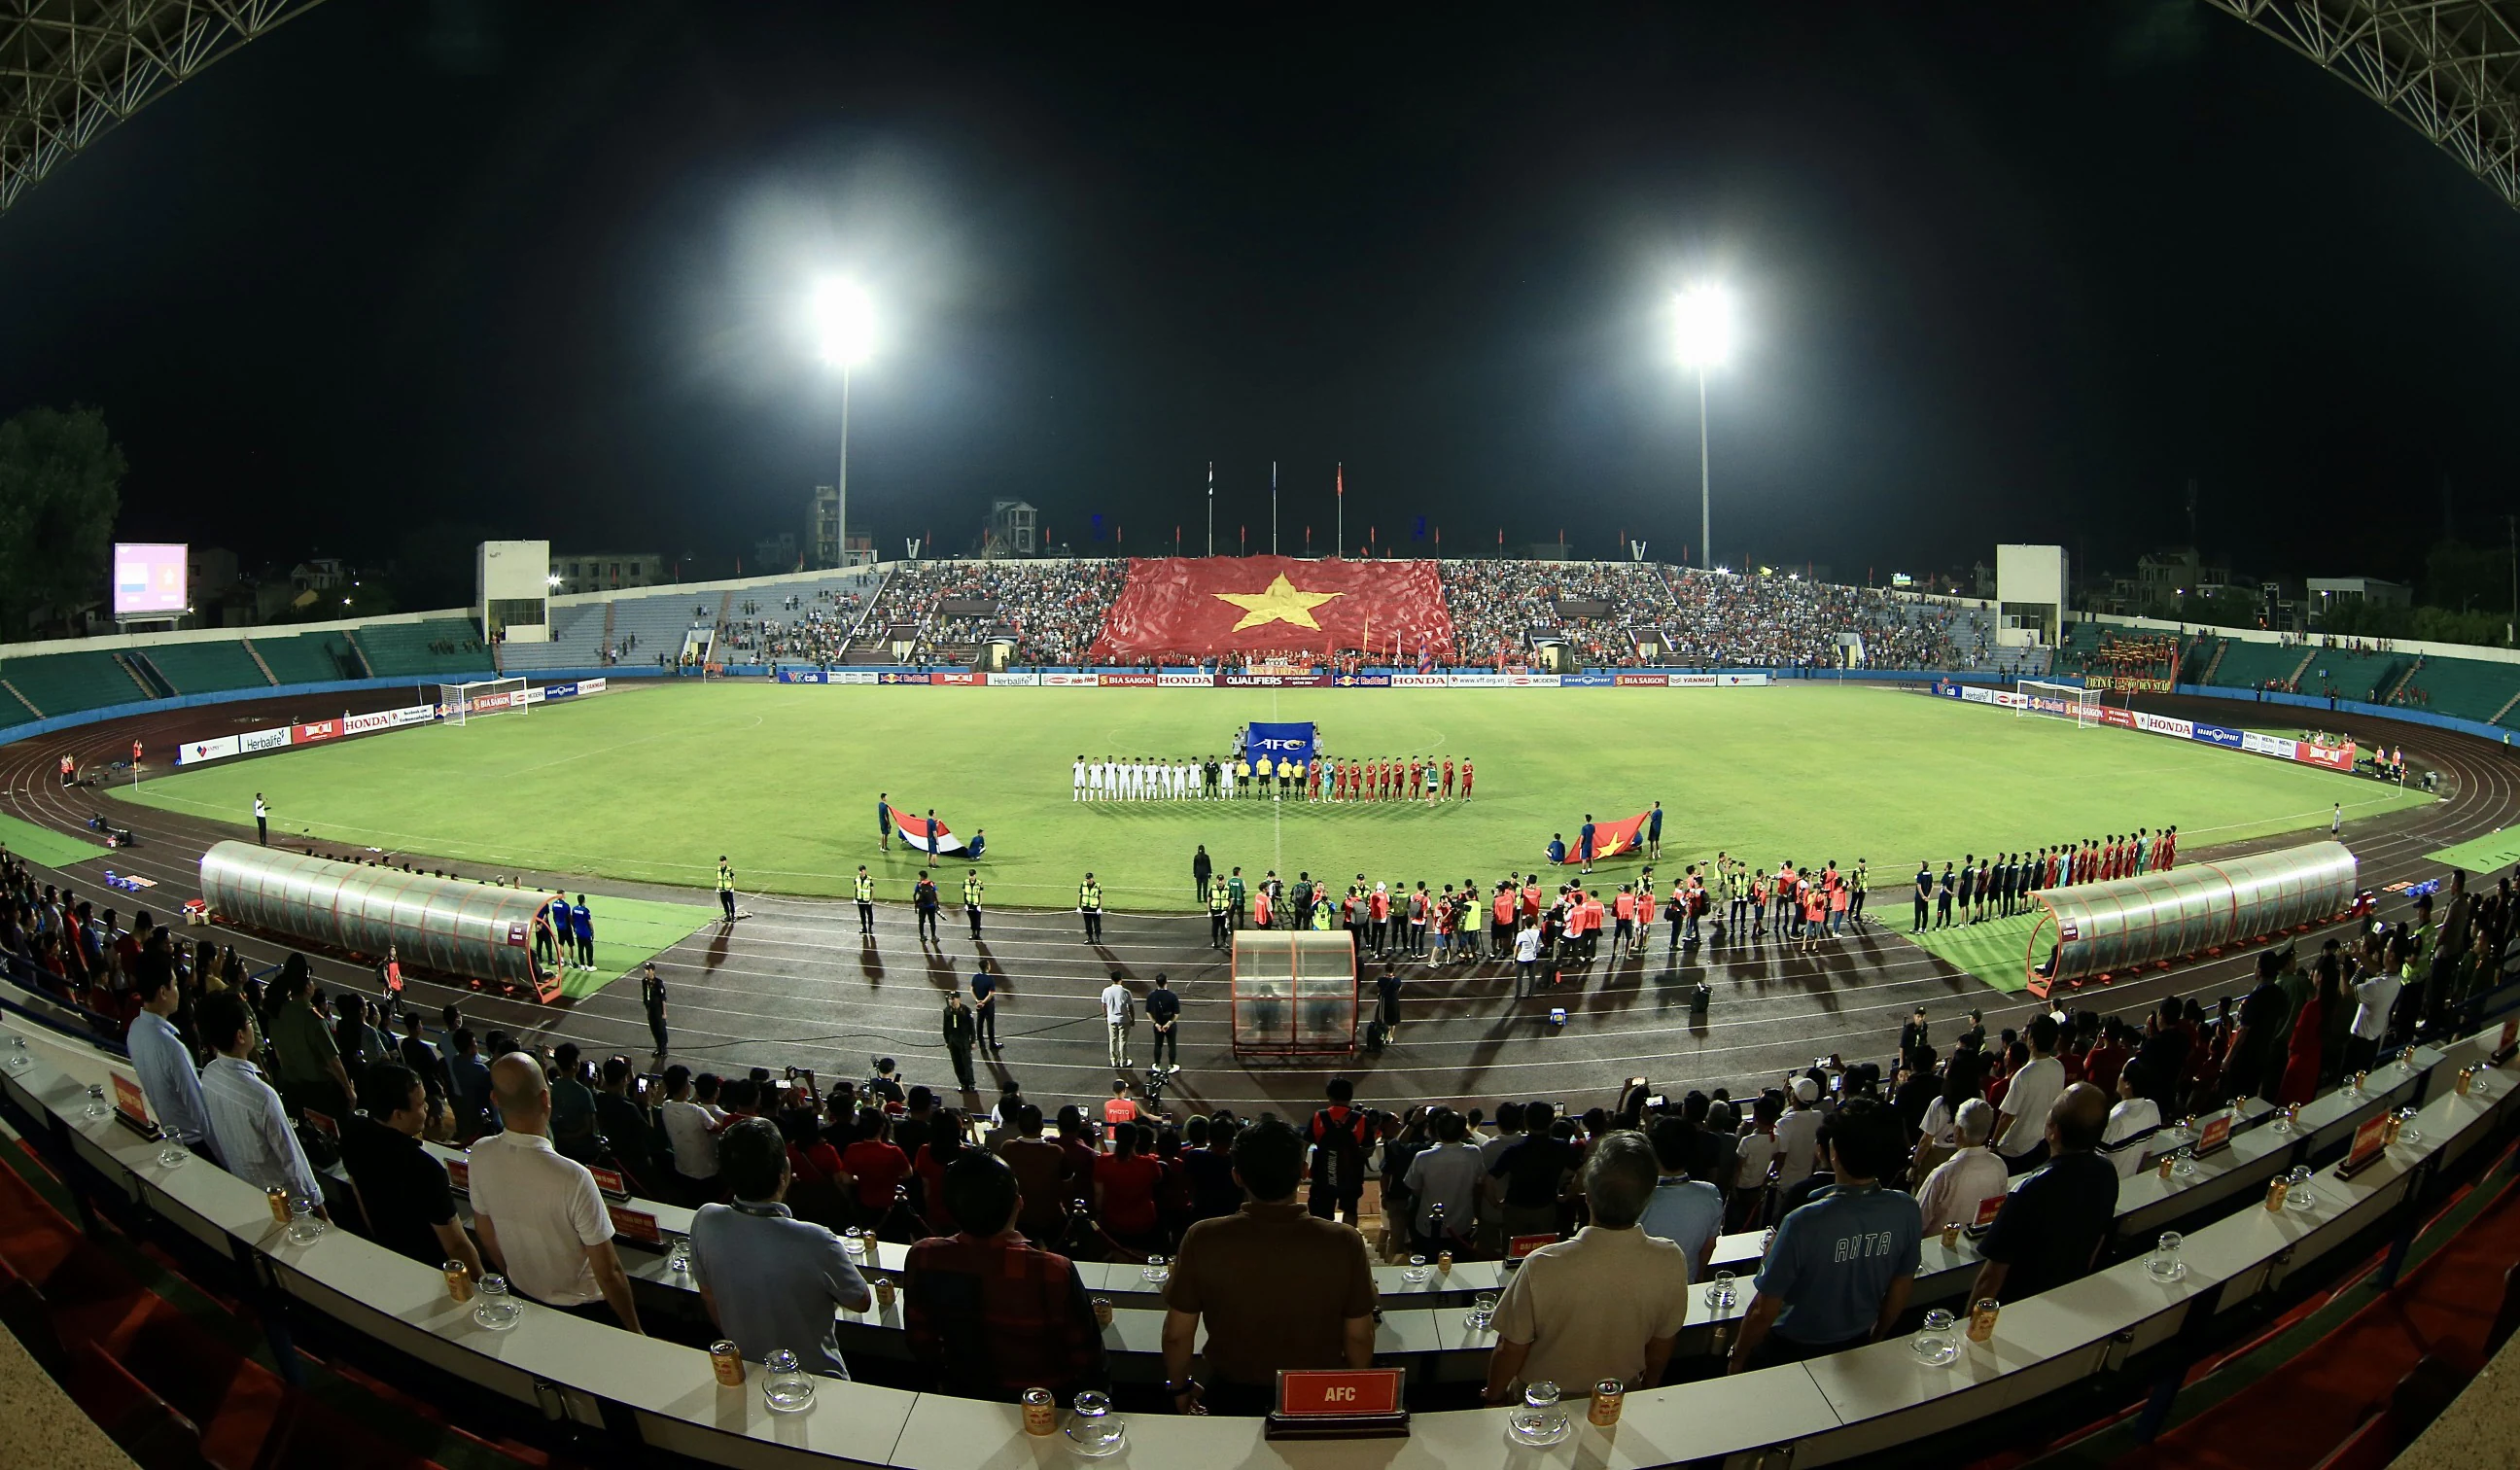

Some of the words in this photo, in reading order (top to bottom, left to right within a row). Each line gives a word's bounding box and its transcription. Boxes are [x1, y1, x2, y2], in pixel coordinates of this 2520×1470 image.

[788, 672, 818, 682] VTVcab
[994, 677, 1030, 685] Herbalife
[1226, 676, 1282, 685] QUALIFIERS
[1361, 677, 1374, 685] Red
[1374, 677, 1388, 685] Bull
[1459, 677, 1505, 685] www.vff.org.vn
[1965, 690, 1987, 702] Herbalife
[480, 699, 490, 709] BIA
[345, 716, 388, 730] HONDA
[2150, 718, 2191, 735] HONDA
[247, 735, 282, 751] Herbalife
[1253, 739, 1306, 751] AFC
[1835, 1231, 1892, 1263] ANTA
[1324, 1386, 1356, 1402] AFC
